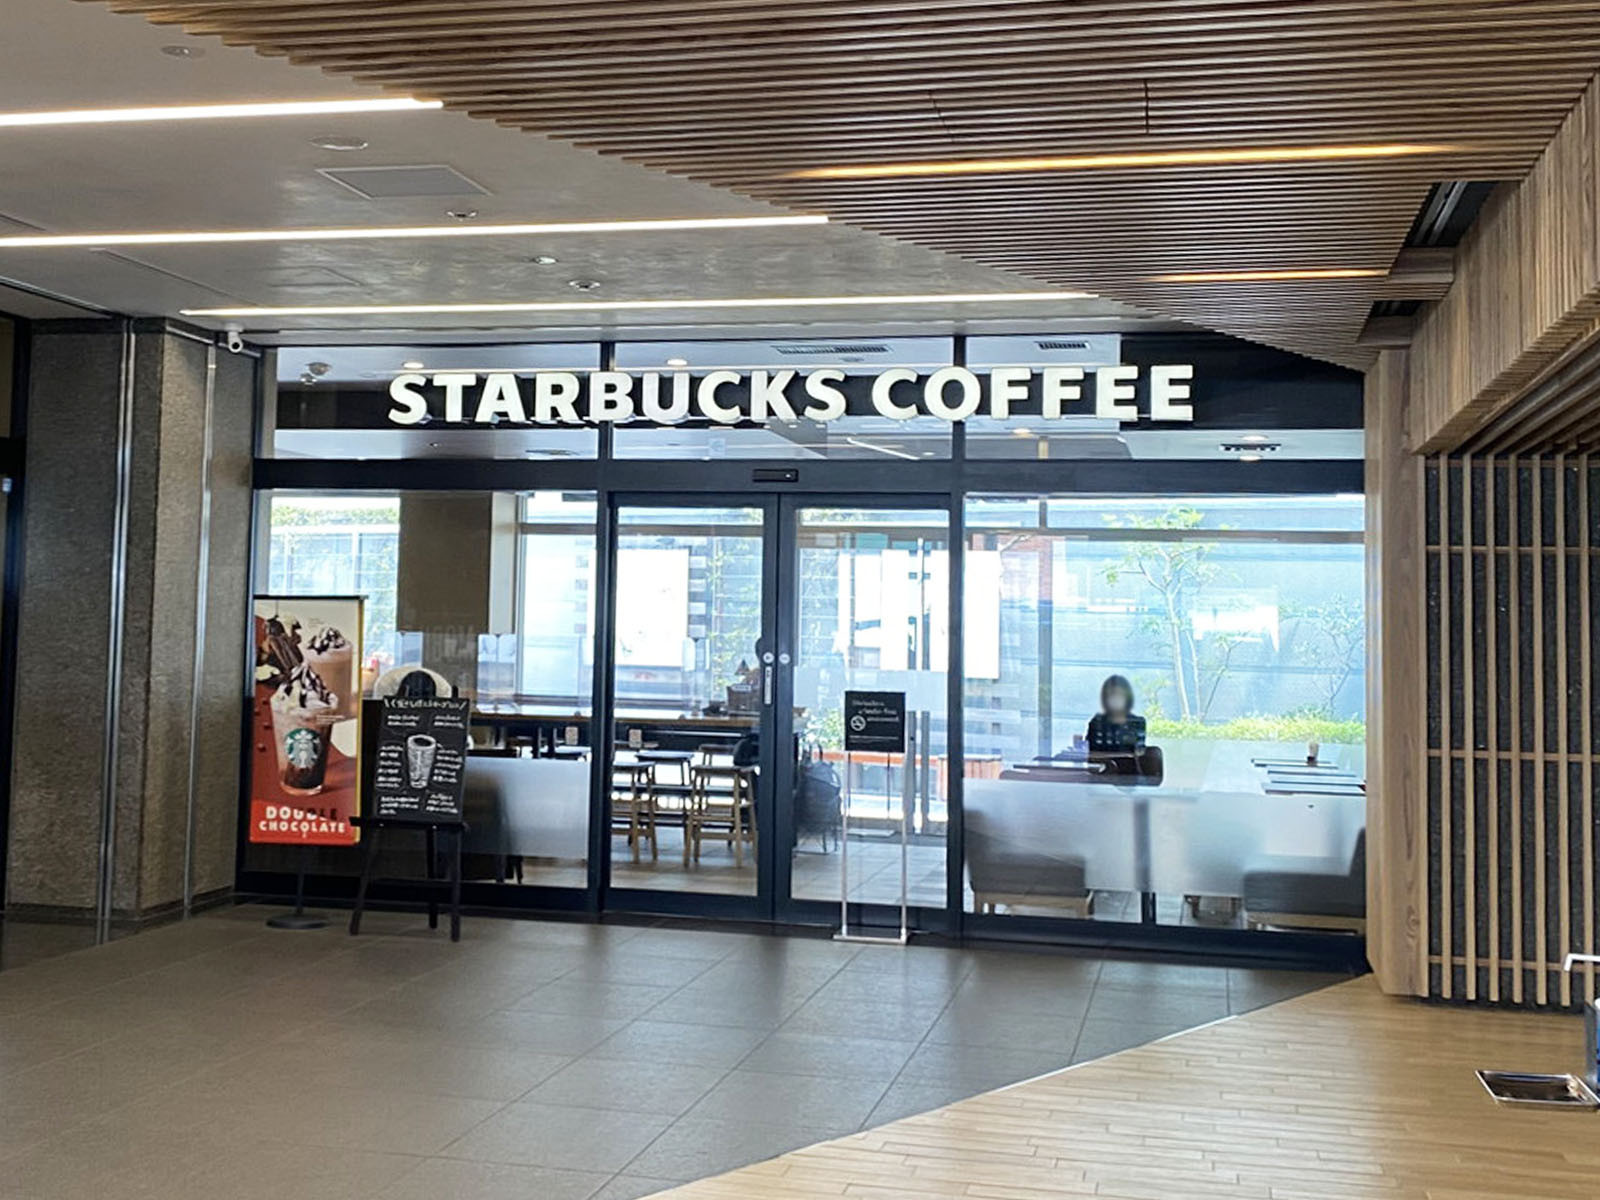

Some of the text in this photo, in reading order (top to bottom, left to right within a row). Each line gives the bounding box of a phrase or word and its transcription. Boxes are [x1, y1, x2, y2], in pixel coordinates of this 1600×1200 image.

[388, 365, 1194, 426] STARBUCKS COFFEE
[265, 806, 338, 821] DOUBLE
[258, 821, 346, 834] CHOCOLATE
